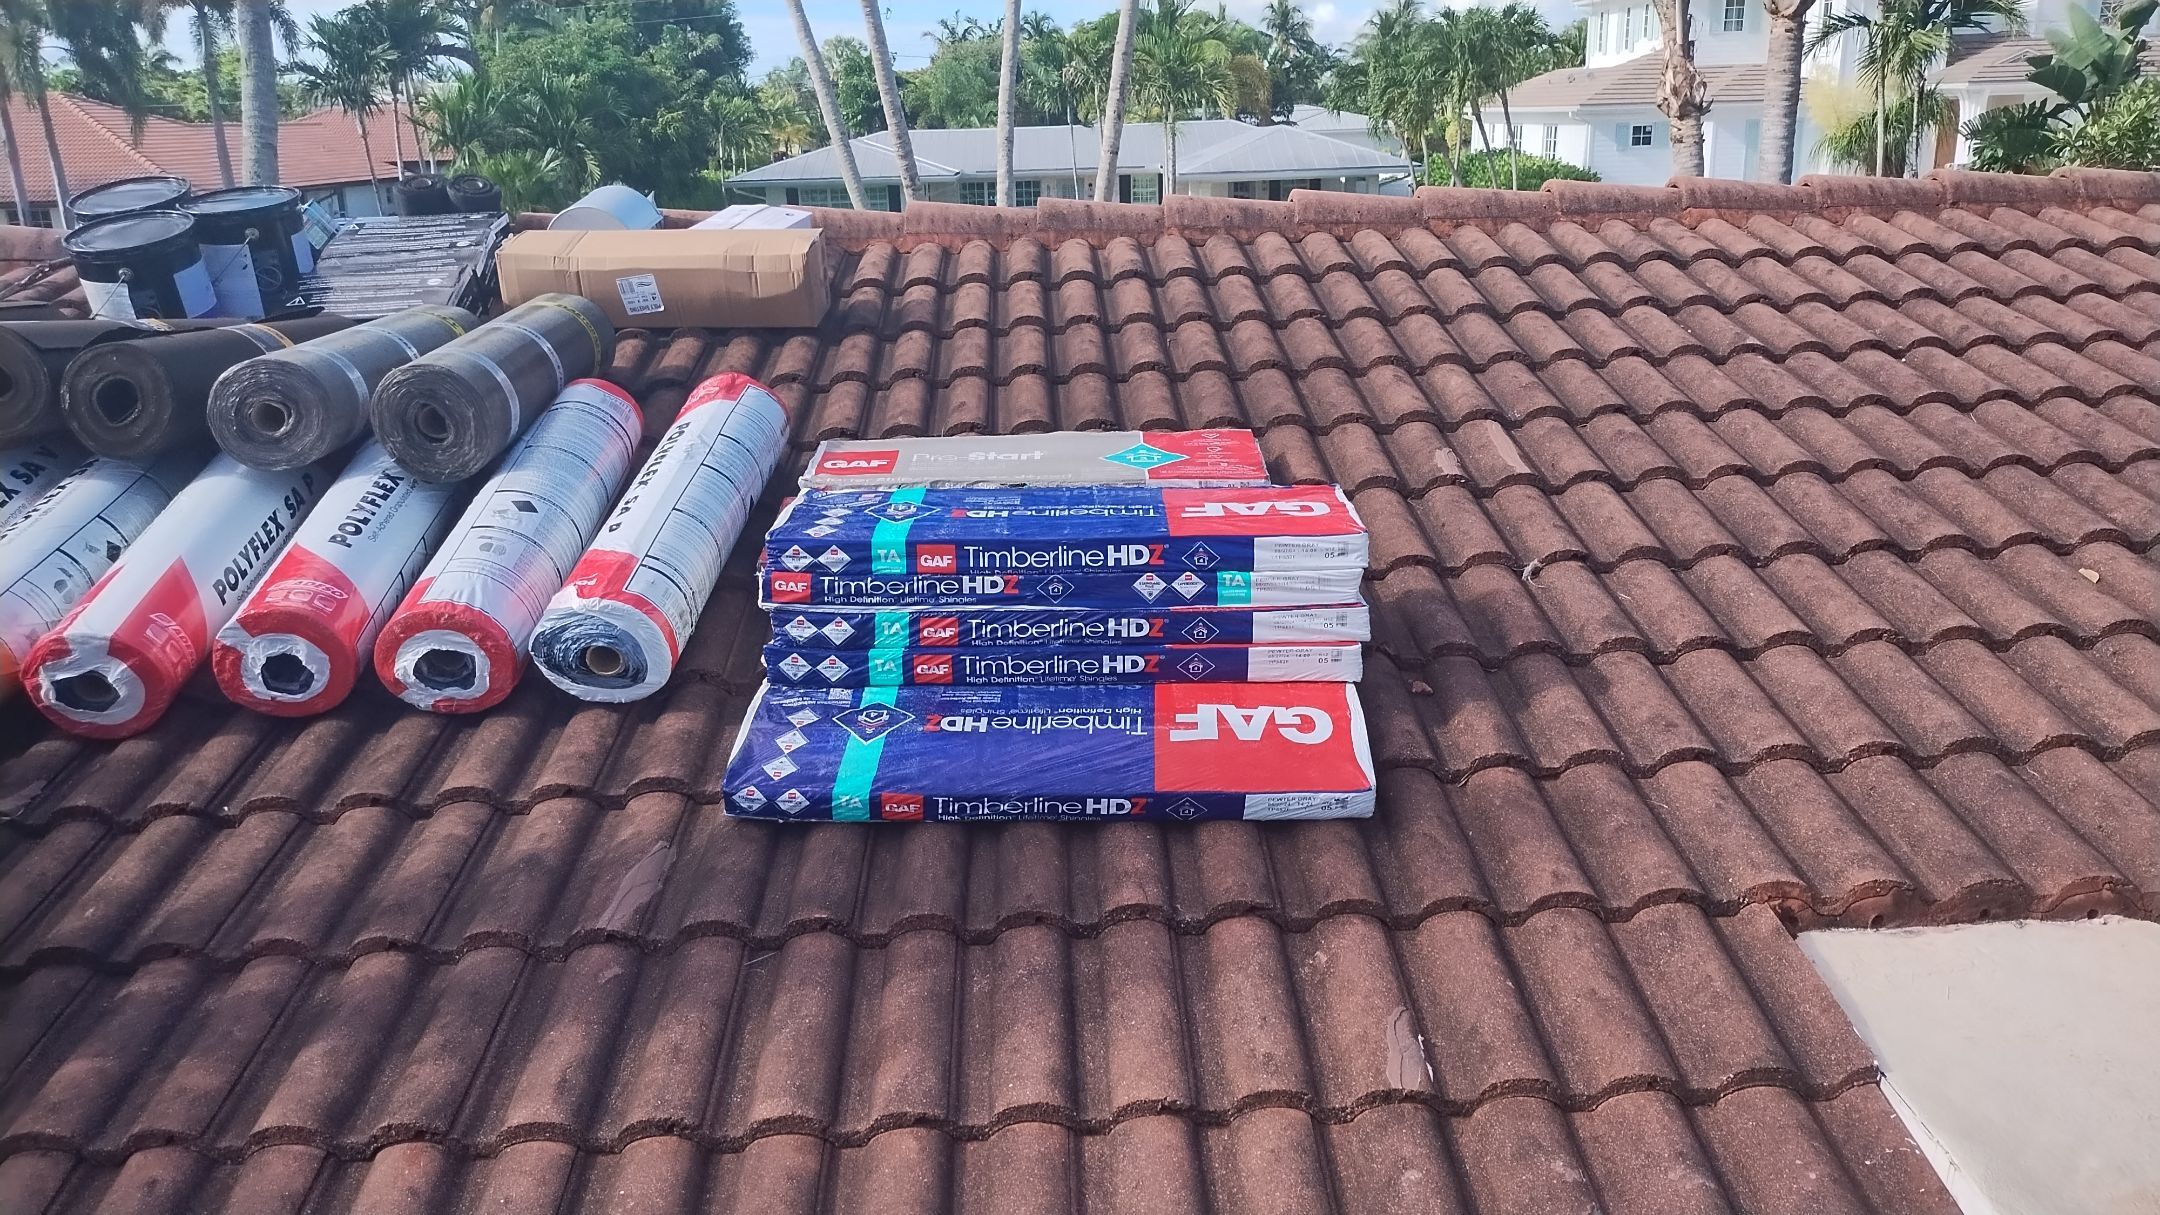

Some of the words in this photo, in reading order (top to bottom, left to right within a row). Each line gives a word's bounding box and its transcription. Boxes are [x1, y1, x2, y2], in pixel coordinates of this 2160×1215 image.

[823, 459, 890, 469] GAF
[911, 450, 1046, 463] Pre-Start
[9, 460, 46, 486] SA
[327, 468, 405, 549] POLYFLEX
[1011, 507, 1161, 518] Timberline
[1181, 501, 1332, 518] GAF
[212, 509, 286, 607] POLYFLEX
[283, 485, 306, 520] SA
[301, 472, 315, 495] P
[877, 549, 901, 564] TA
[920, 555, 953, 568] GAF
[964, 546, 1105, 567] Timberline
[1107, 544, 1165, 566] HDZ
[774, 580, 808, 593] GAF
[820, 576, 962, 595] Timberline
[962, 575, 1020, 594] HDZ
[1222, 573, 1246, 587] TA
[824, 596, 847, 604] High
[938, 596, 977, 604] Shingles
[881, 621, 903, 636] TA
[923, 627, 956, 639] GAF
[967, 619, 1105, 638] Timberline
[1107, 617, 1165, 638] HDZ
[874, 659, 897, 673] TA
[916, 664, 949, 675] GAF
[960, 655, 1100, 675] Timberline
[1102, 655, 1160, 674] HDZ
[966, 676, 989, 684] High
[1115, 707, 1142, 715] High
[923, 714, 989, 733] HDZ
[991, 714, 1148, 736] Timberline
[1169, 703, 1334, 745] GAF
[885, 802, 921, 813] GAF
[933, 797, 1082, 814] Timberline
[1086, 797, 1148, 815] HDZ
